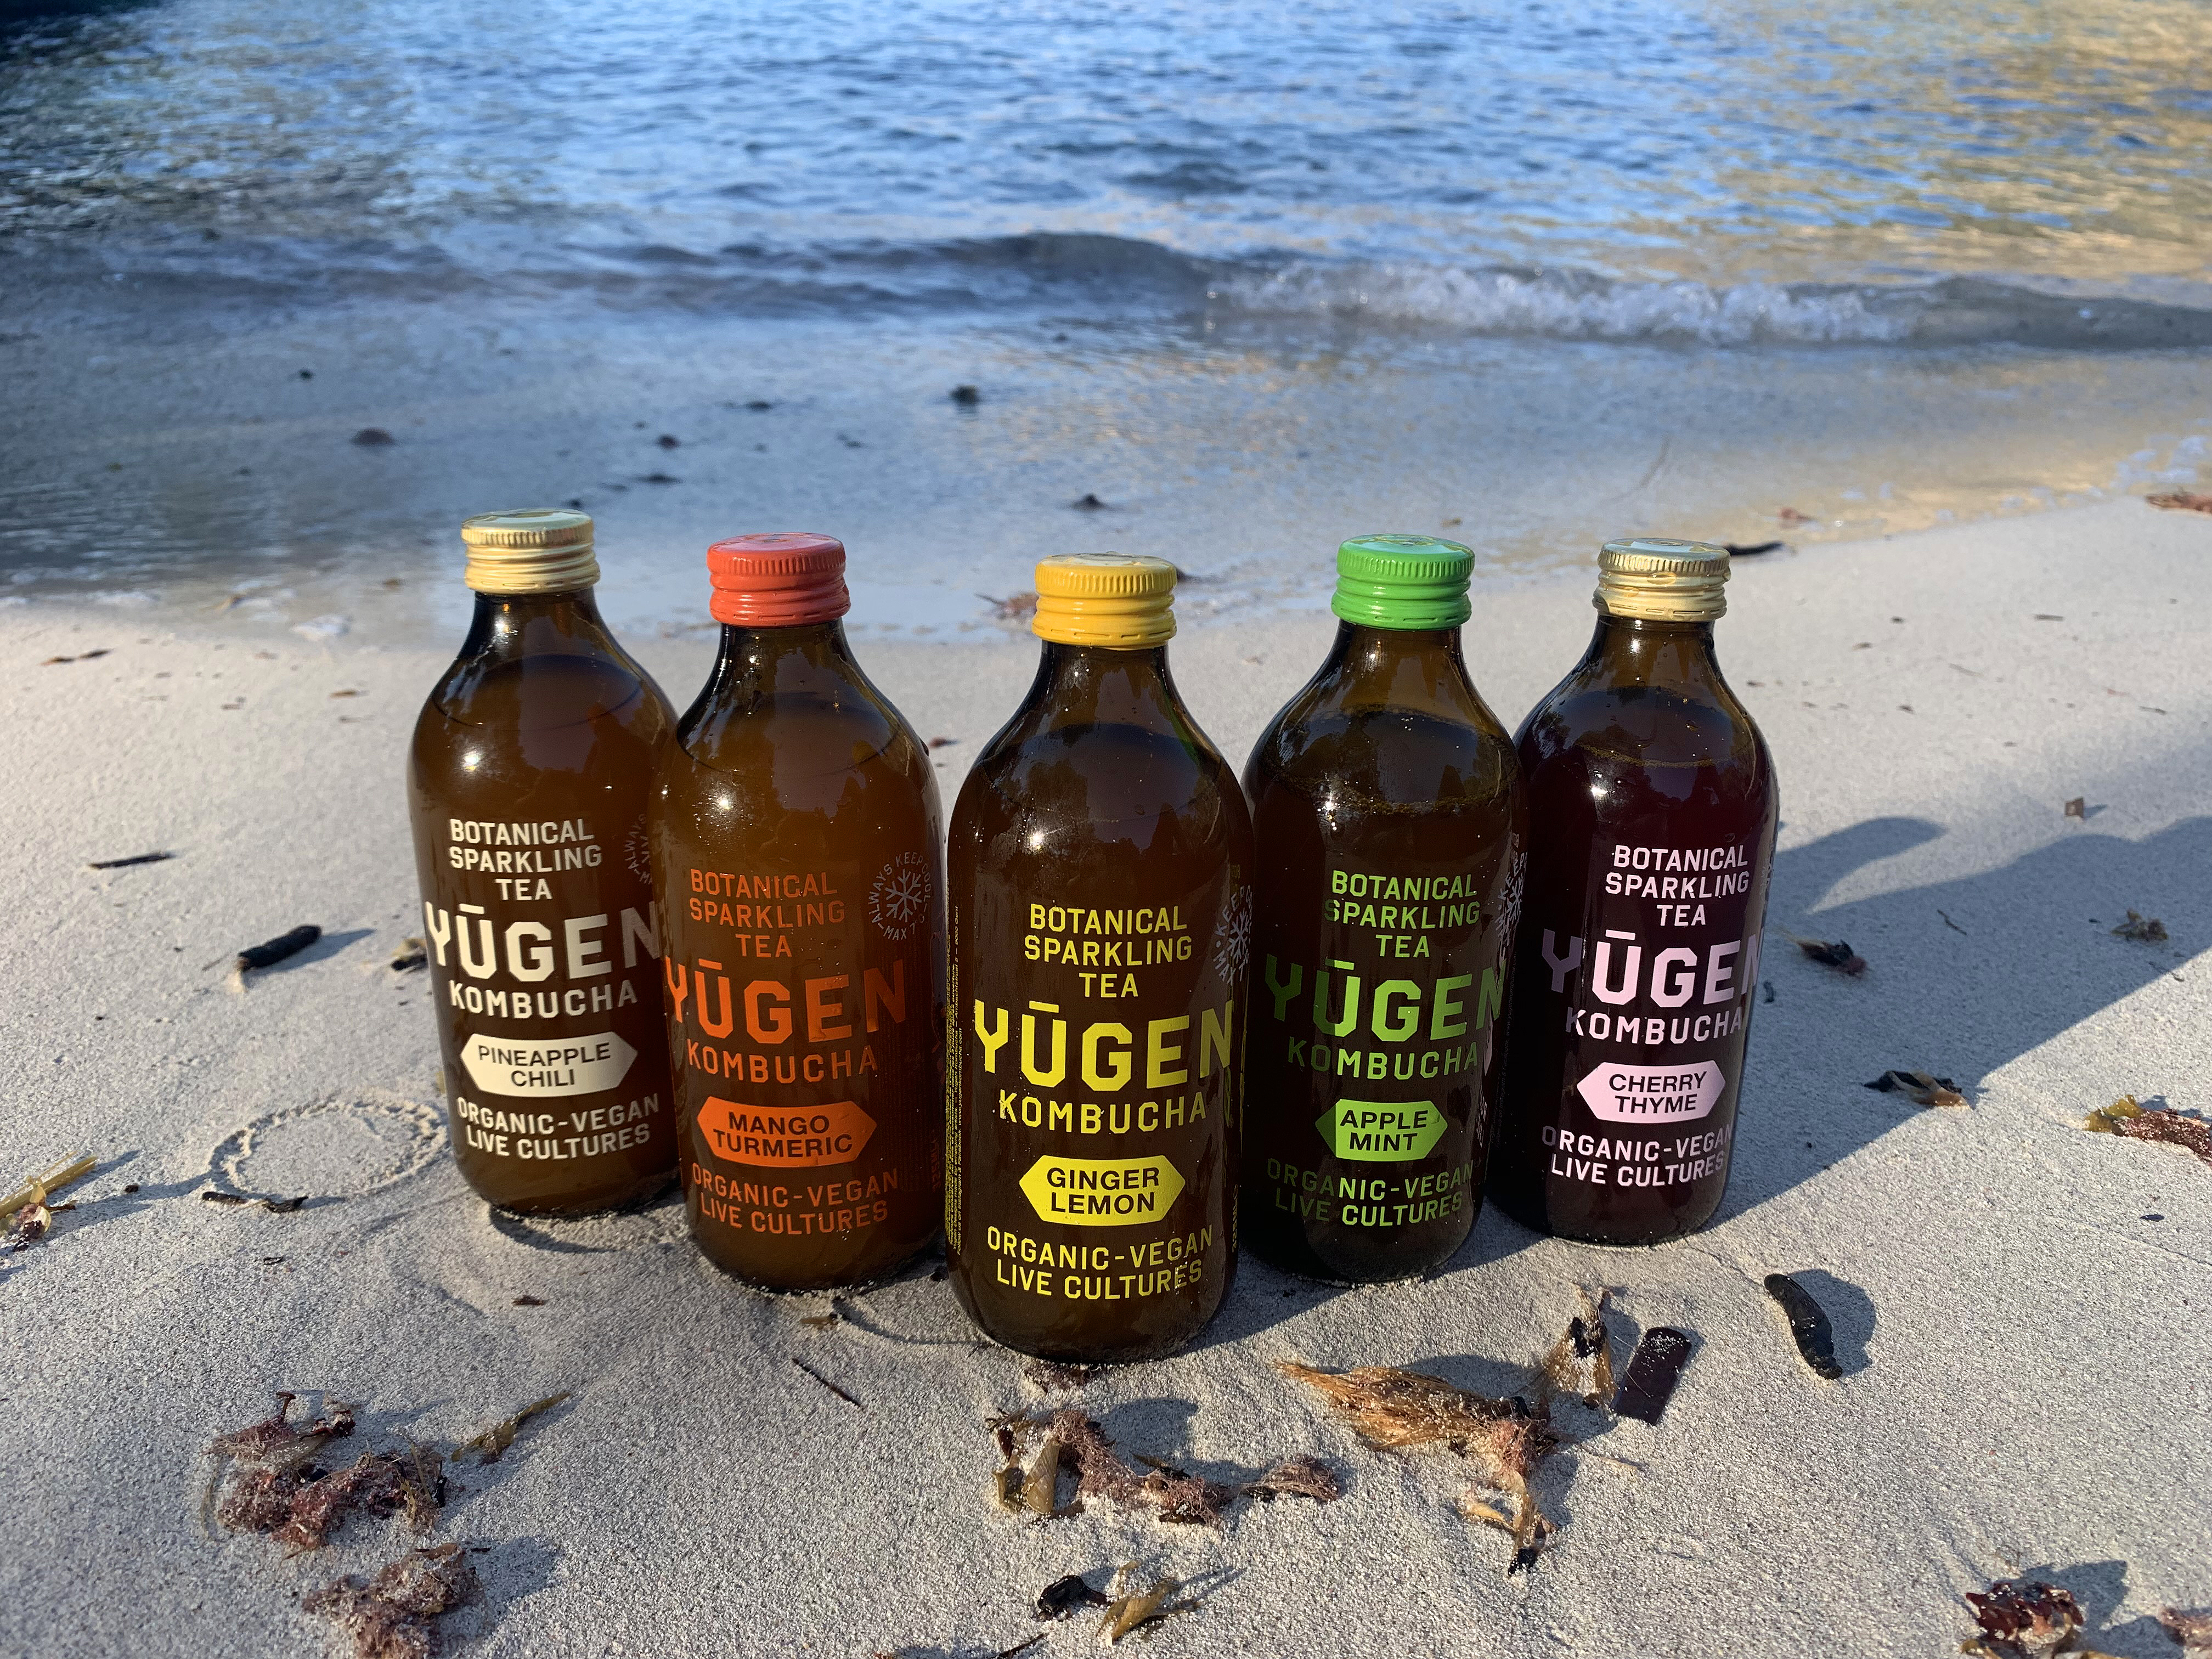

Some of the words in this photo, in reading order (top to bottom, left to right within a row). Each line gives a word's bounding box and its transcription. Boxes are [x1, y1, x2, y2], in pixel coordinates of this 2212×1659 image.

[449, 819, 594, 845] BOTANICAL
[449, 845, 602, 873] SPARKLING
[1613, 844, 1748, 872] BOTANICAL
[494, 878, 552, 901] TEA
[690, 868, 838, 899] BOTANICAL
[868, 864, 893, 923] ALWAYS
[895, 851, 923, 867] KEEP
[921, 863, 932, 902] COOL
[1331, 870, 1477, 901] BOTANICAL
[1605, 871, 1750, 899] SPARKLING
[690, 898, 846, 928] SPARKLING
[1030, 903, 1188, 934] BOTANICAL
[1215, 885, 1245, 936] KEEP
[1325, 899, 1481, 929] SPARKLING
[1657, 904, 1706, 927] TEA
[735, 934, 792, 958] TEA
[883, 925, 907, 940] MAX
[1375, 934, 1430, 958] TEA
[1024, 934, 1192, 967] SPARKLING
[1212, 950, 1237, 986] MAX
[448, 979, 638, 1019] KOMBUCHA
[664, 955, 907, 1043] YŪGEN
[1079, 973, 1138, 998] TEA
[1265, 953, 1507, 1042] YŪGEN
[1566, 1007, 1743, 1045] KOMBUCHA
[477, 1042, 612, 1067] PINEAPPLE
[974, 998, 1234, 1092] YŪGEN
[1288, 1036, 1479, 1080] KOMBUCHA
[686, 1038, 878, 1084] KOMBUCHA
[510, 1068, 575, 1087] CHILI
[1609, 1071, 1707, 1092] CHERRY
[457, 1092, 659, 1135] ORGANIC-VEGAN
[998, 1088, 1207, 1135] KOMBUCHA
[1615, 1094, 1697, 1113] THYME
[728, 1111, 830, 1135] MANGO
[1340, 1110, 1429, 1130] APPLE
[466, 1124, 510, 1156] LIVE
[517, 1122, 651, 1160] CULTURES
[713, 1129, 853, 1158] TURMERIC
[1348, 1132, 1418, 1152] MINT
[1542, 1122, 1734, 1162] ORGANIC-VEGAN
[1047, 1166, 1160, 1189] GINGER
[1267, 1158, 1475, 1200] ORGANIC-VEGAN
[1551, 1156, 1606, 1184] LIVE
[1617, 1149, 1724, 1187] CULTURES
[692, 1161, 899, 1207] ORGANIC-VEGAN
[701, 1195, 743, 1228] LIVE
[751, 1199, 888, 1235] CULTURES
[1051, 1191, 1155, 1215] LEMON
[1276, 1188, 1331, 1223] LIVE
[1341, 1190, 1463, 1227] CULTURES
[988, 1224, 1213, 1271] ORGANIC-VEGAN
[997, 1259, 1053, 1296] LIVE
[1064, 1259, 1202, 1301] CULTURES
